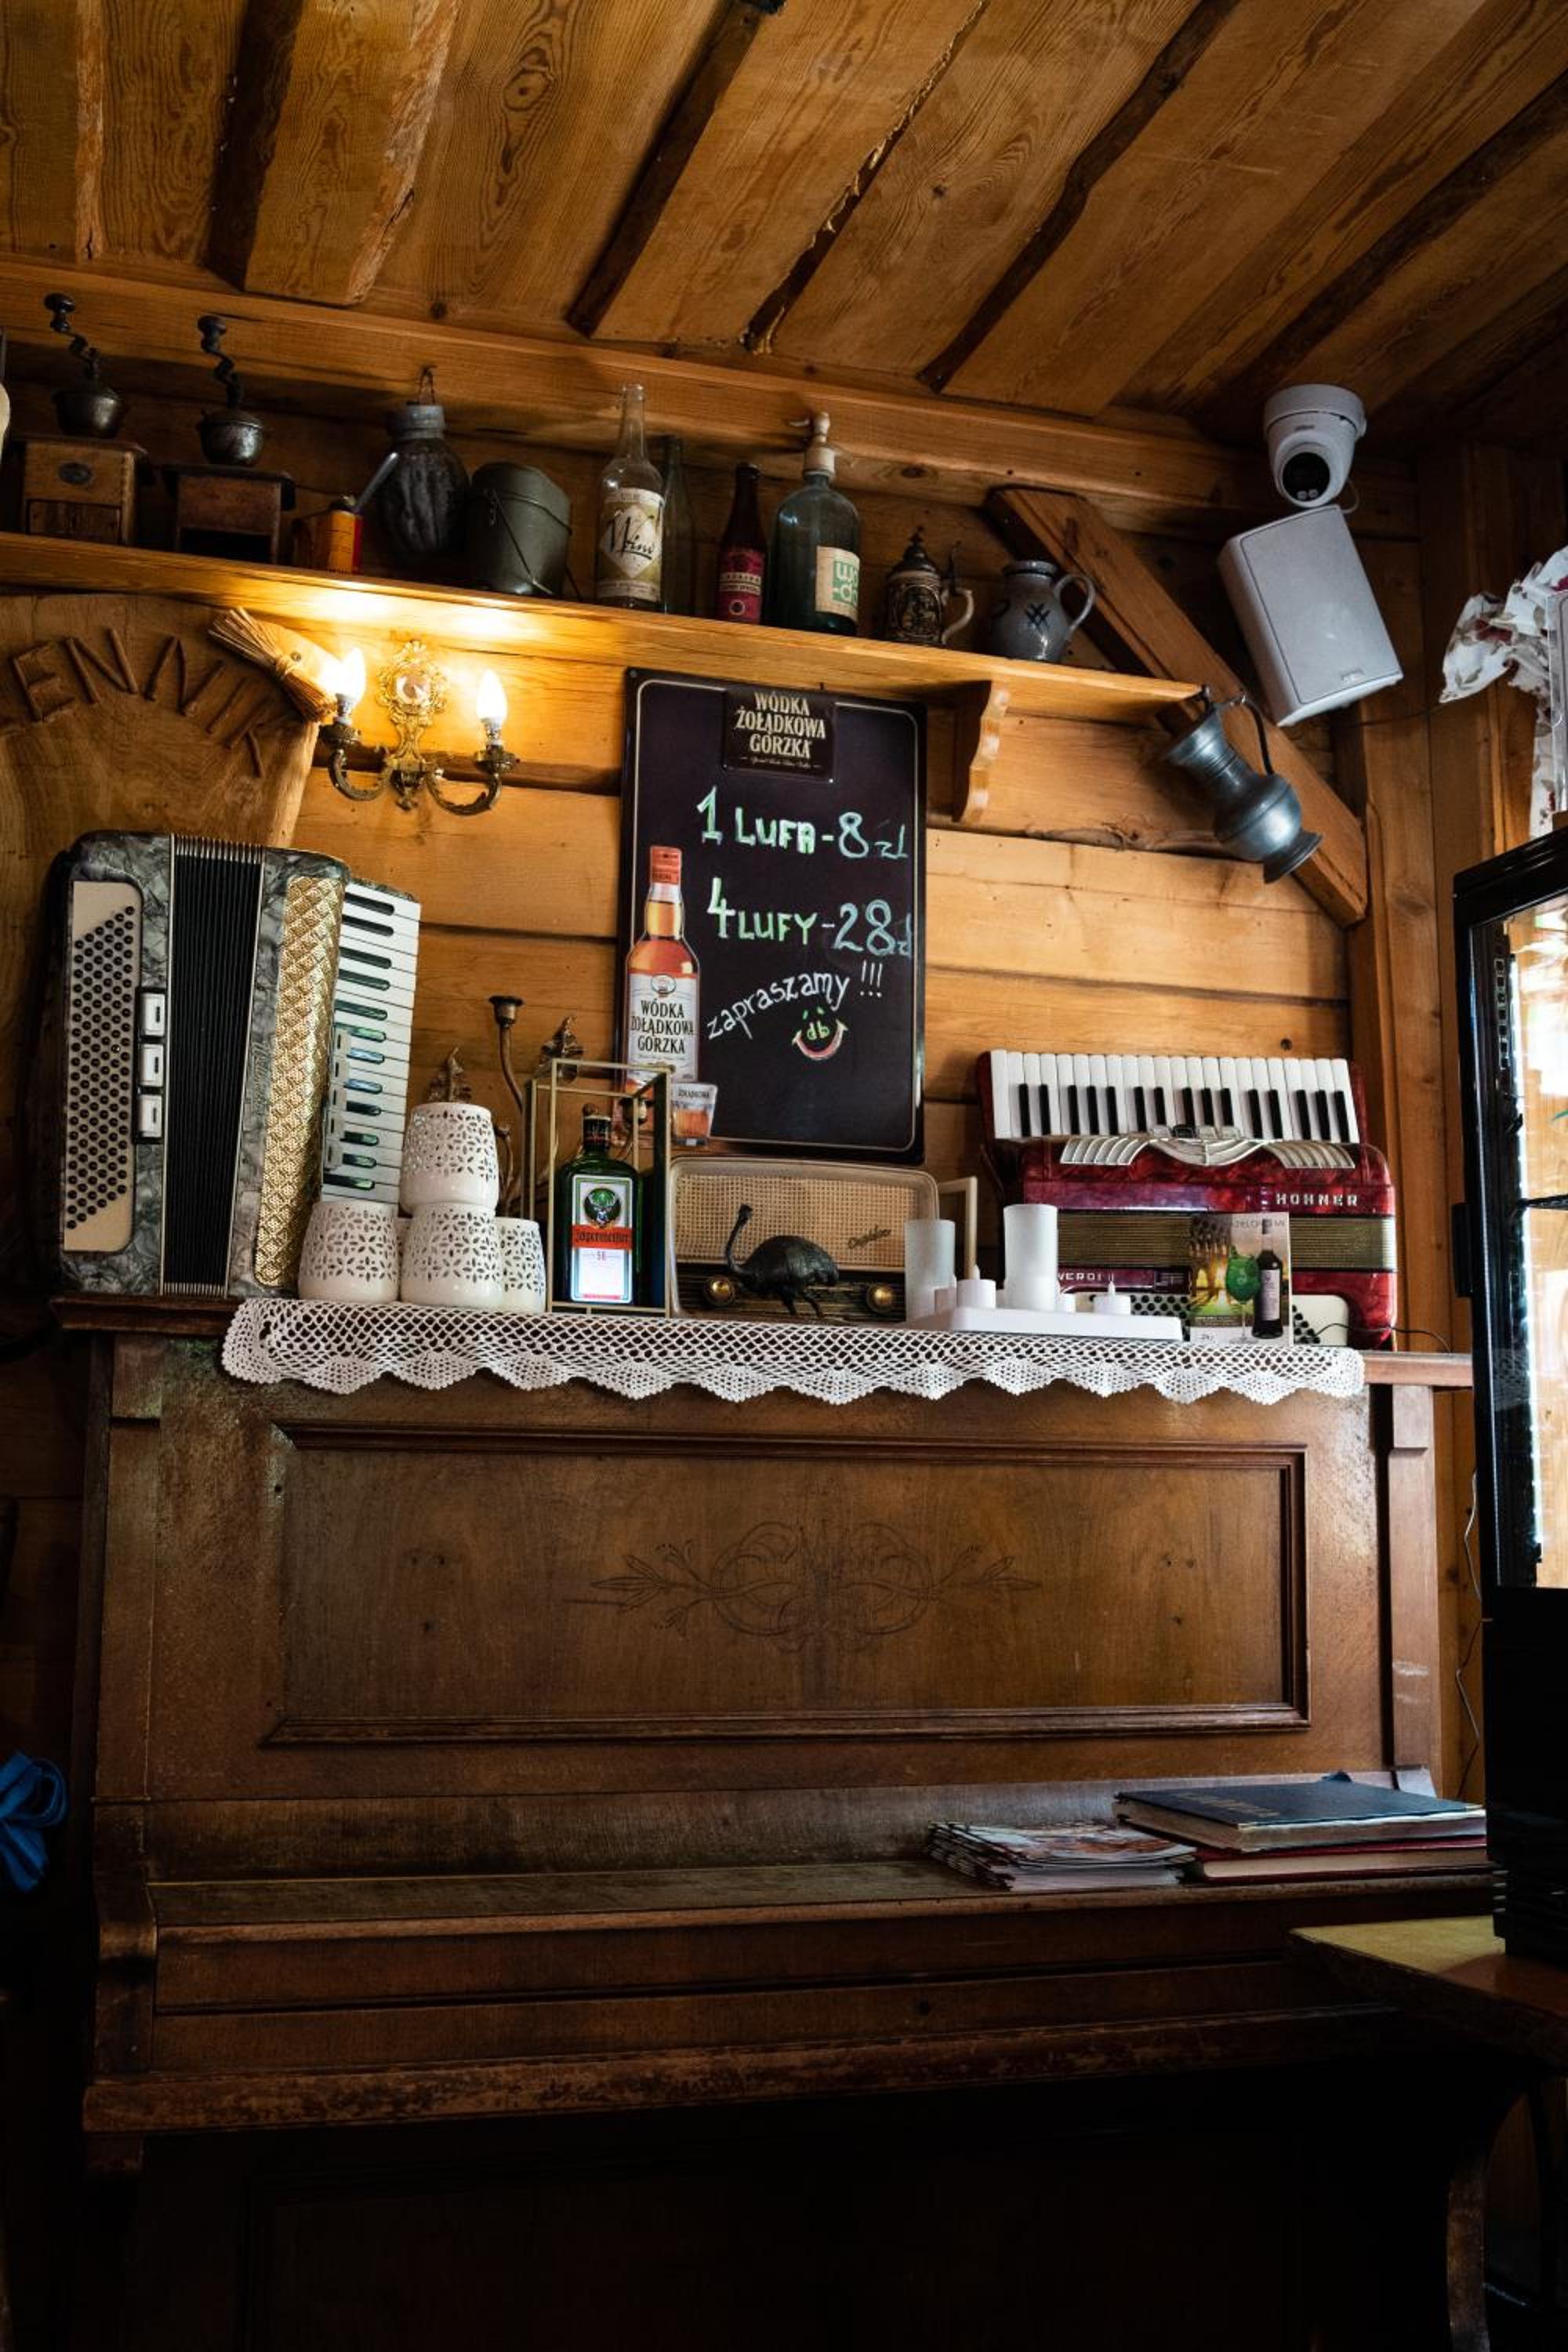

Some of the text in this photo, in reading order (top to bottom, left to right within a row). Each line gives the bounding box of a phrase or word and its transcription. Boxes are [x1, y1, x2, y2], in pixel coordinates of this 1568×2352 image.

[754, 691, 810, 716] WÓDKA
[734, 706, 826, 739] ŻOŁĄDKOWA
[696, 786, 723, 845] 1
[707, 877, 736, 938] 4
[641, 998, 684, 1018] WÓDKA
[707, 972, 850, 1040] zapraszamy
[637, 1035, 686, 1054] GORZKA
[1276, 1192, 1358, 1206] HOHNER
[1058, 1272, 1102, 1281] VERDI
